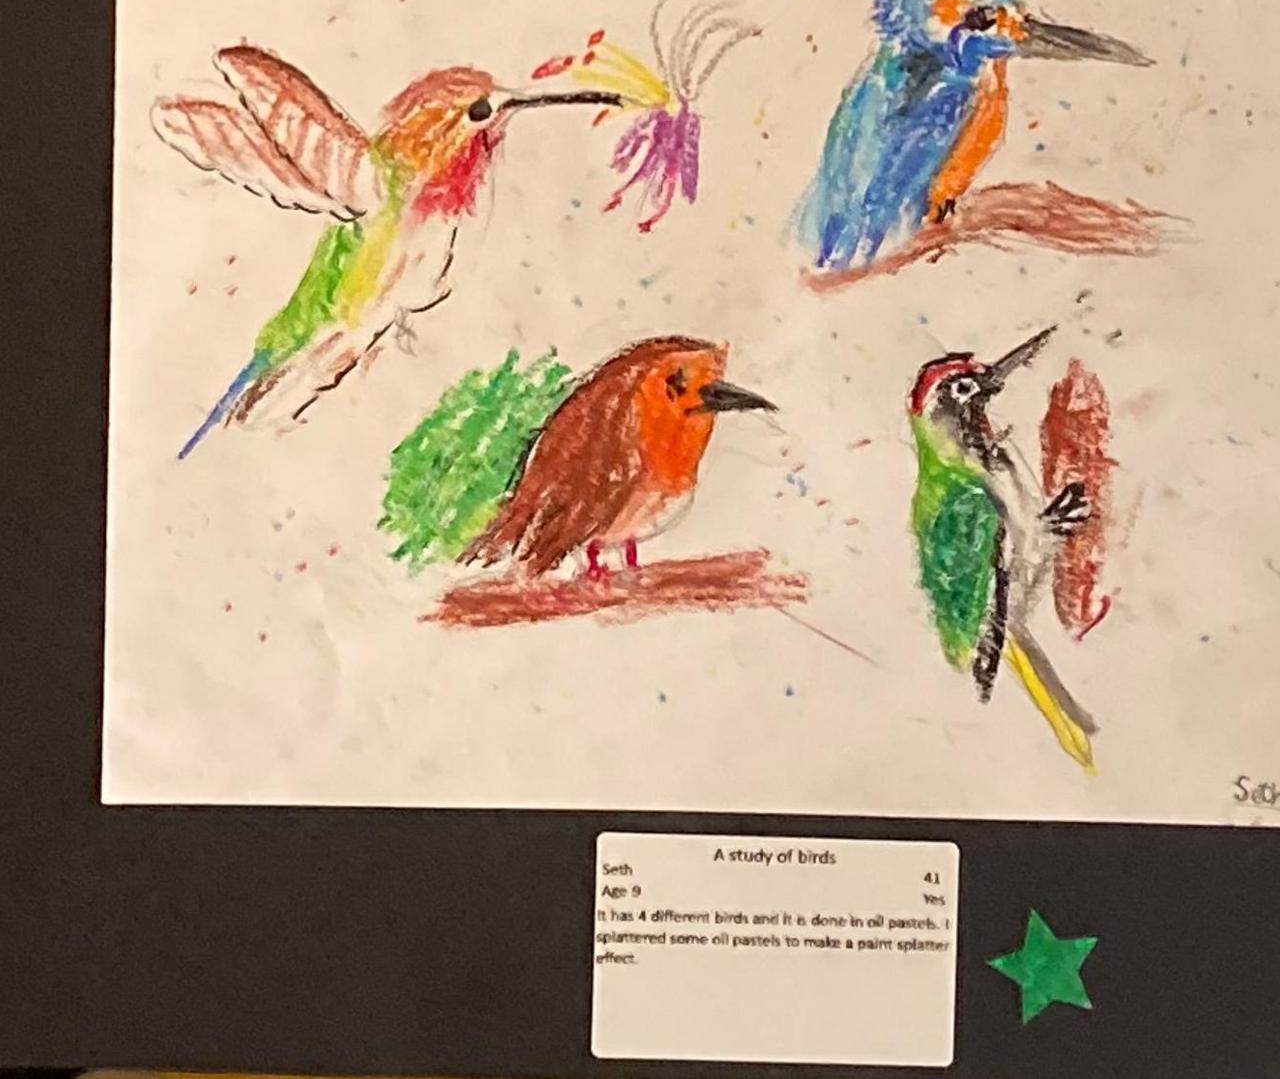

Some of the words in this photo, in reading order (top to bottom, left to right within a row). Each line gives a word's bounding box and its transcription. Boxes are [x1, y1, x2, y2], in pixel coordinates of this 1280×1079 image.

[713, 848, 726, 862] A
[729, 849, 774, 867] study
[776, 849, 794, 864] of
[798, 850, 837, 865] birds
[601, 863, 634, 877] Seth
[923, 872, 941, 886] 41
[601, 885, 628, 899] Age
[631, 885, 642, 898] 9
[923, 893, 947, 907] Yes
[597, 909, 607, 922] It
[610, 909, 635, 923] has
[637, 910, 647, 923] 4
[650, 909, 710, 924] different
[714, 911, 749, 925] birds
[752, 912, 780, 926] and
[782, 912, 793, 926] it
[796, 914, 807, 927] is
[811, 913, 847, 928] done
[850, 914, 864, 928] in
[866, 915, 885, 929] oil
[888, 916, 940, 931] pastels.
[596, 931, 667, 946] splattered
[669, 934, 709, 946] some
[711, 932, 729, 946] oil
[732, 933, 781, 948] pastels
[785, 935, 800, 948] to
[804, 936, 841, 950] make
[845, 939, 854, 950] a
[857, 936, 894, 952] paint
[897, 937, 951, 953] splatter
